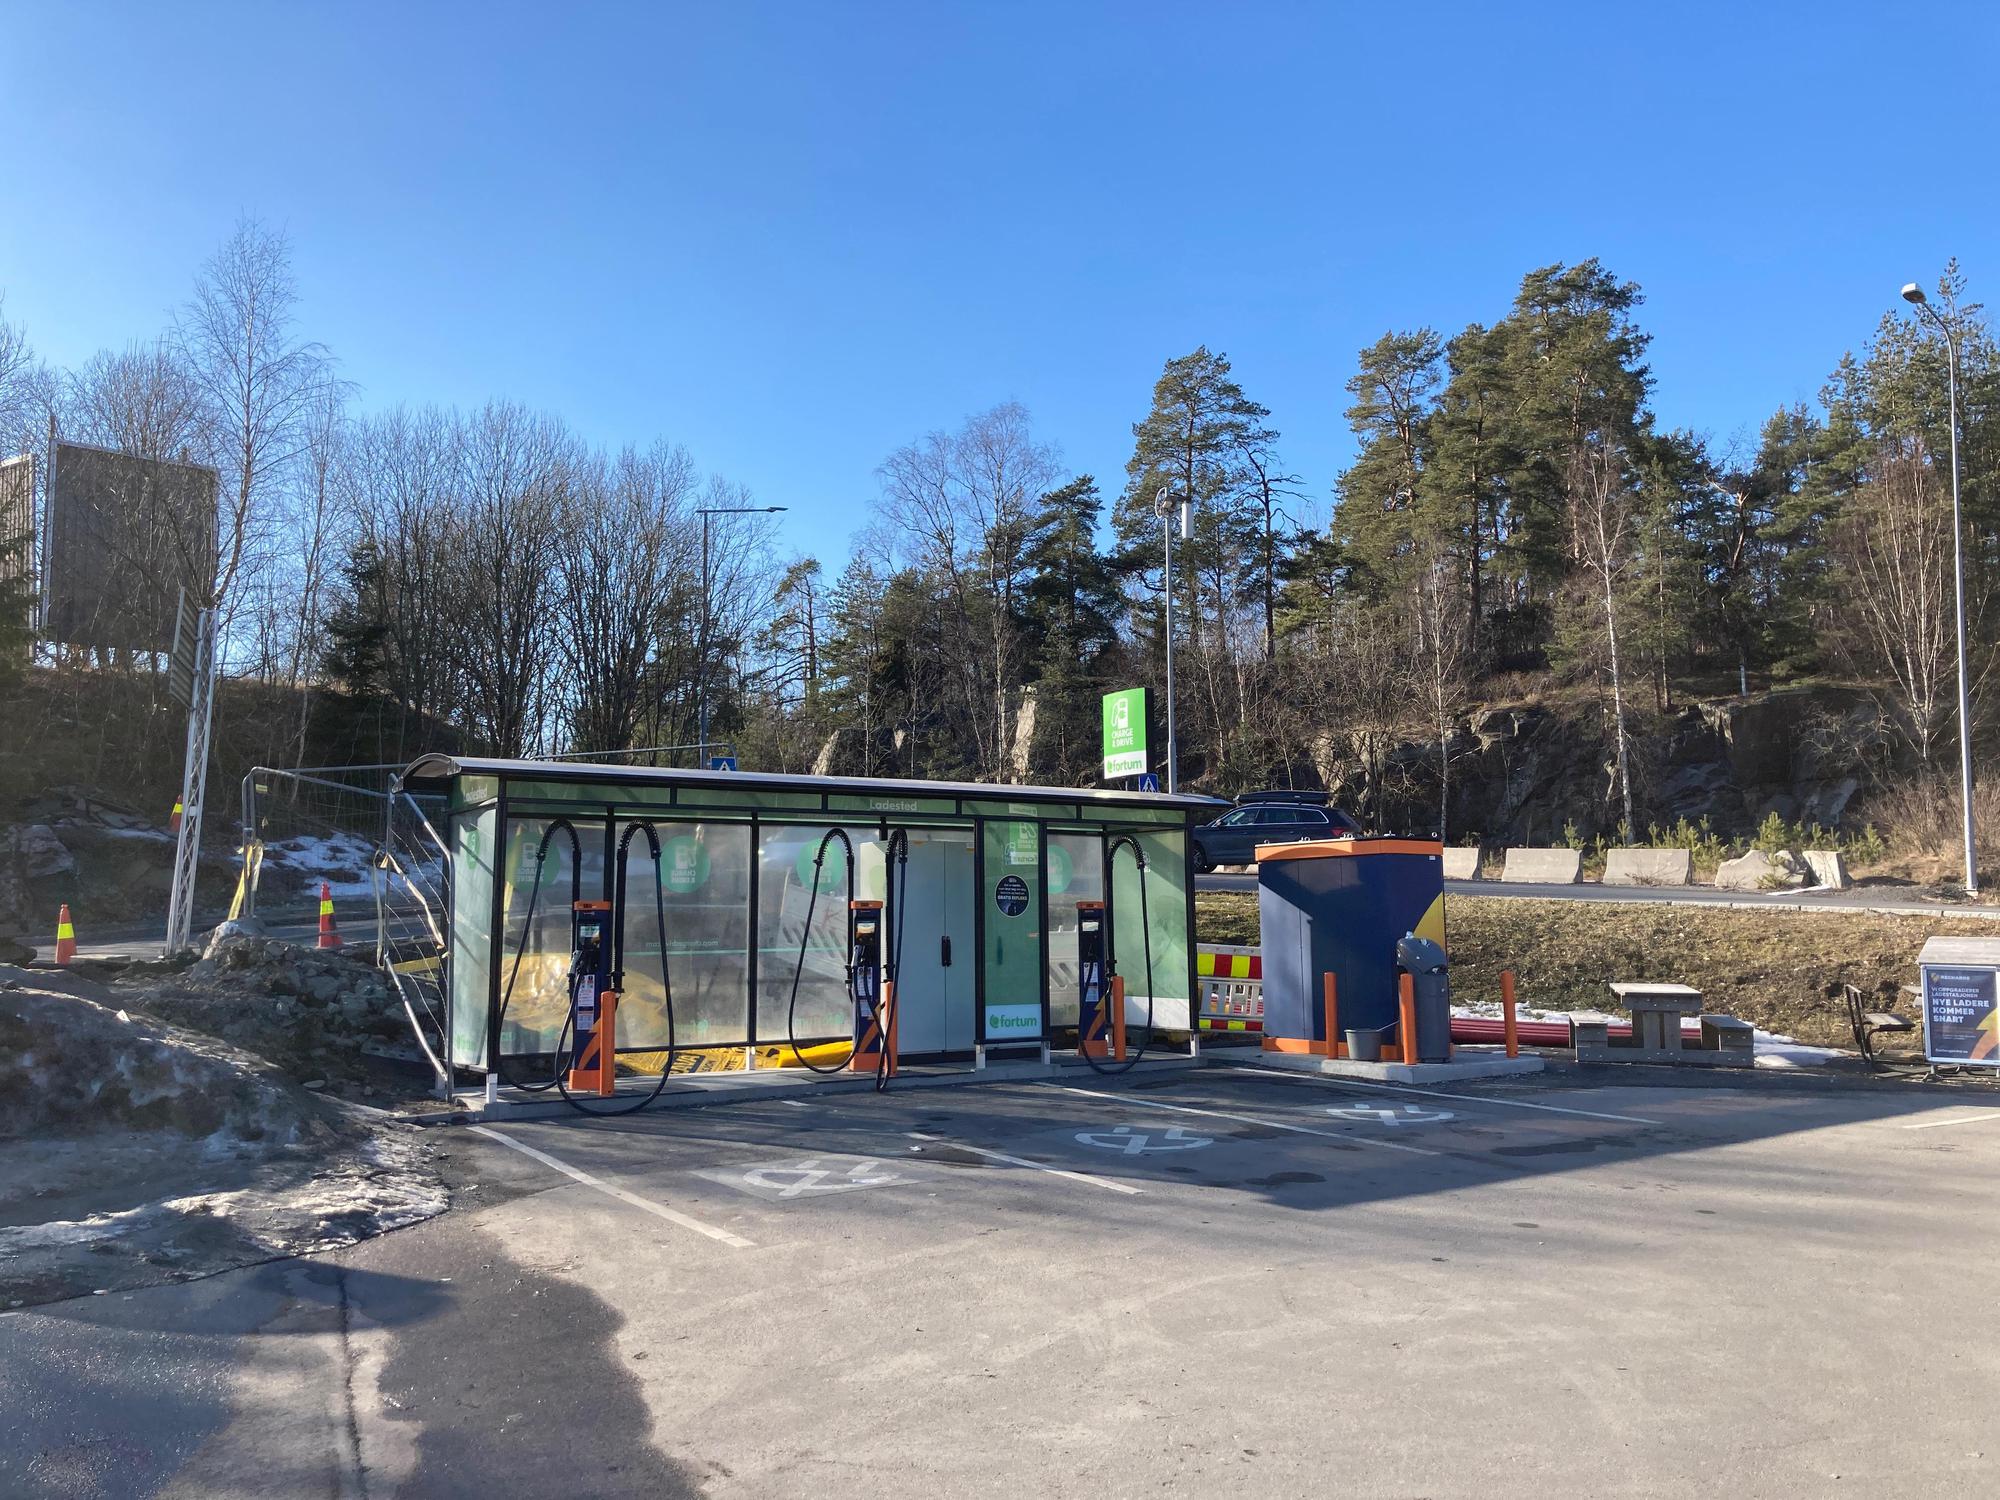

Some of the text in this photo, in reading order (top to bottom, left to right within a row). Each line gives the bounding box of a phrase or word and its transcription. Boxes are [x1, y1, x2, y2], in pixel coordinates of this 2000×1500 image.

[1112, 728, 1133, 738] CHARGE
[1113, 759, 1142, 772] fortum
[870, 800, 917, 811] Ladested
[1954, 999, 1989, 1007] LADERE
[1933, 1007, 1975, 1015] KOMMER
[1000, 1014, 1037, 1028] fortum
[1933, 1015, 1964, 1023] SNART
